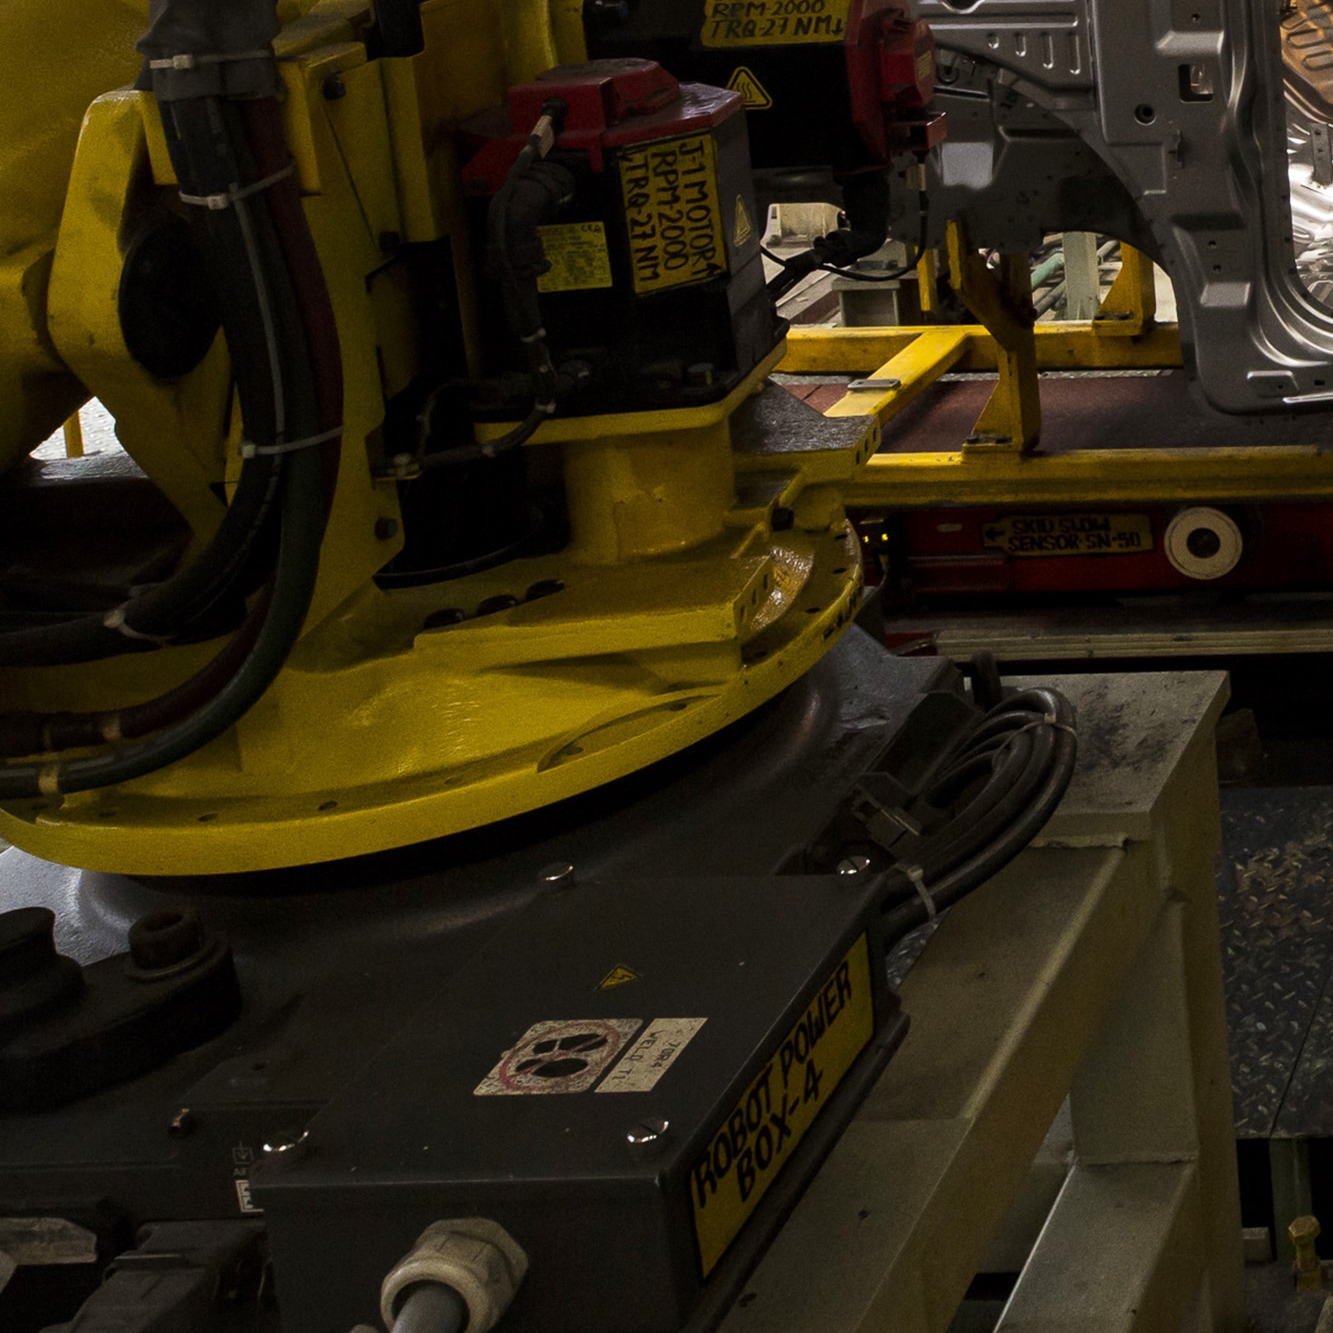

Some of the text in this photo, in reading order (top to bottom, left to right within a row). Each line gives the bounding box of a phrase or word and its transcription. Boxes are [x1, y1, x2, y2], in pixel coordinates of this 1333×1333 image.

[793, 14, 832, 36] NM
[651, 149, 690, 271] RPM-2000
[678, 141, 717, 267] J-1 MOTOR
[695, 960, 852, 1209] ROBOT POWER
[736, 1057, 824, 1203] BOX-4
